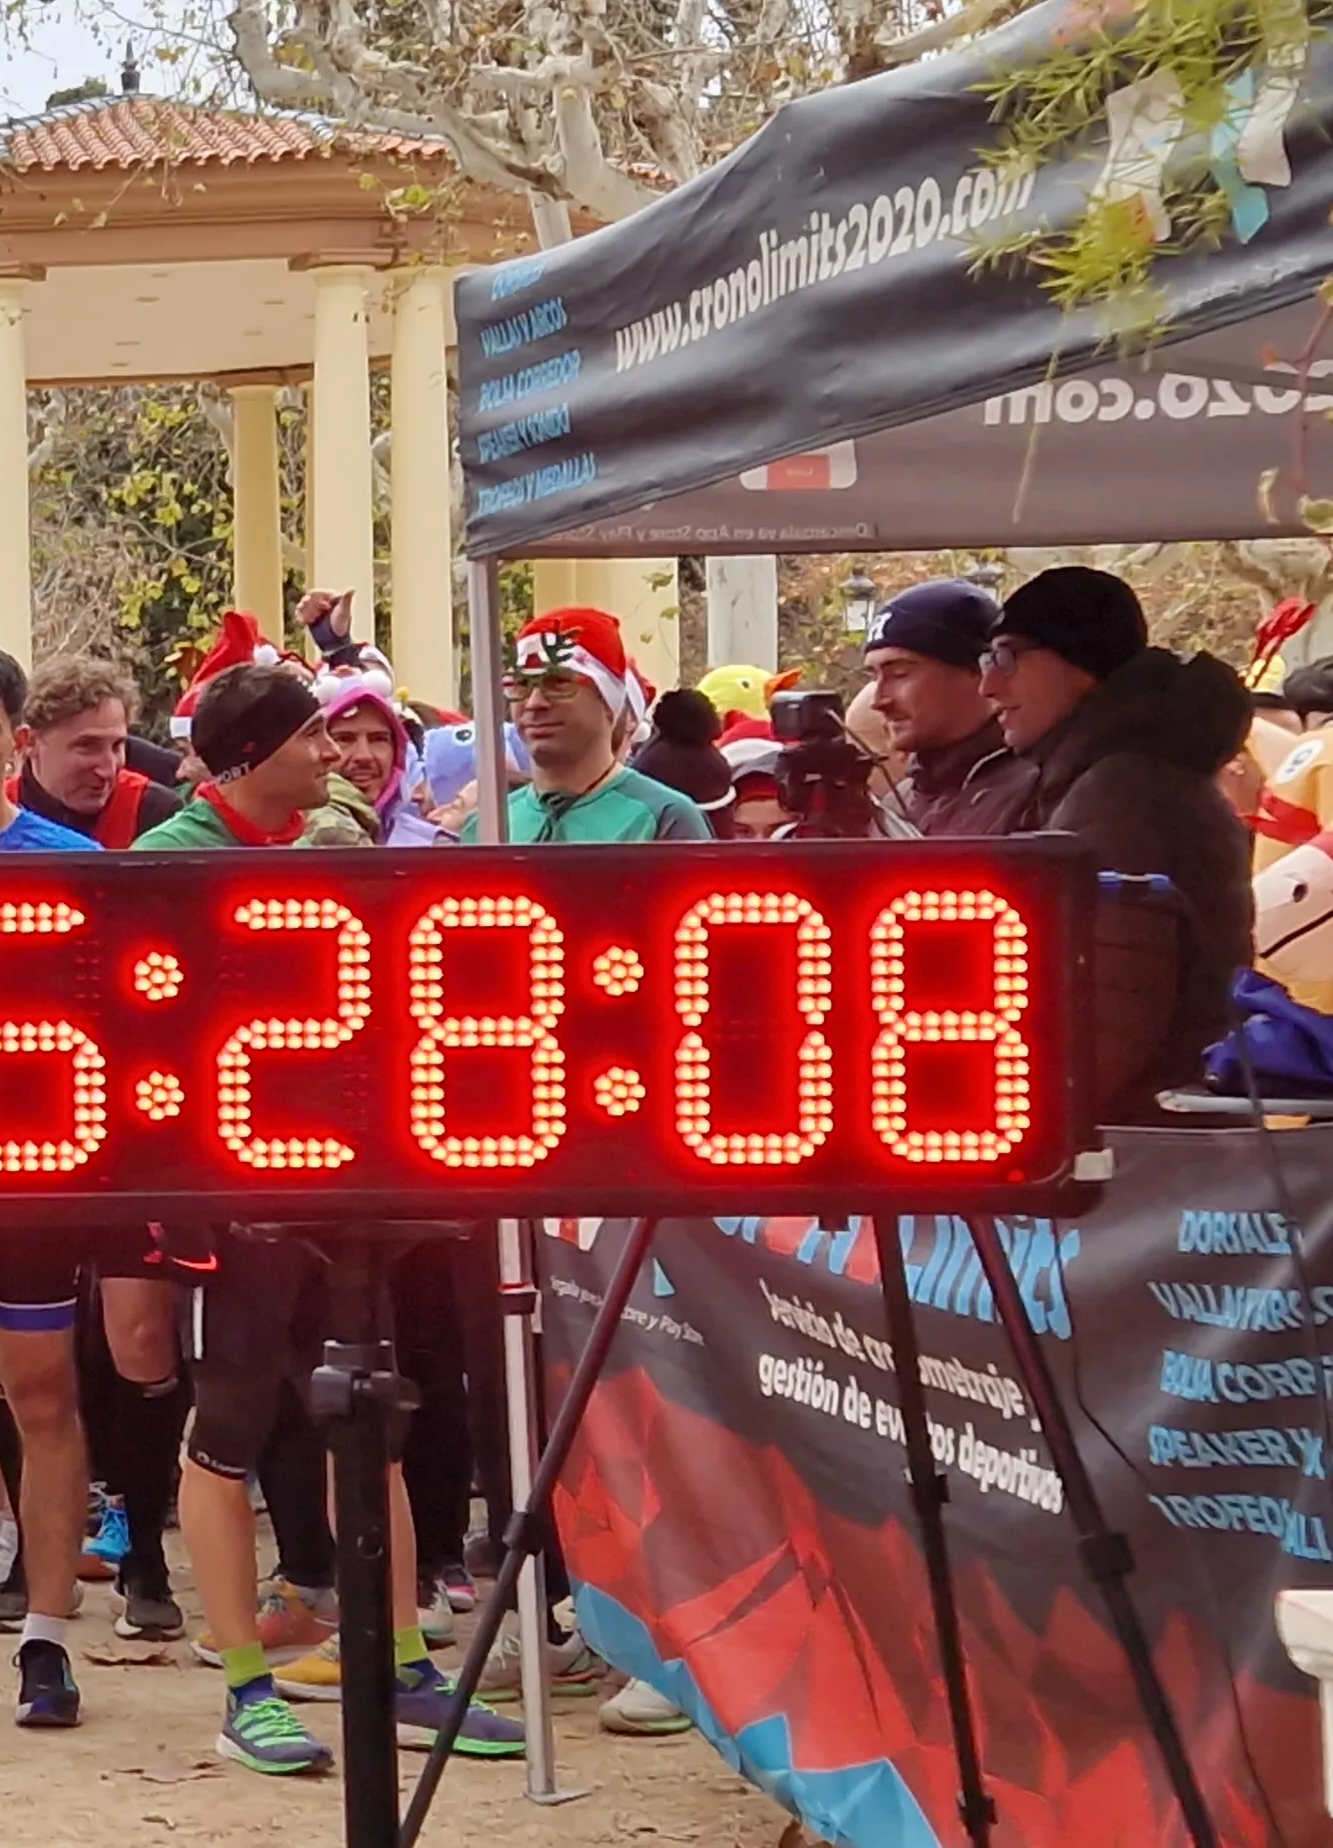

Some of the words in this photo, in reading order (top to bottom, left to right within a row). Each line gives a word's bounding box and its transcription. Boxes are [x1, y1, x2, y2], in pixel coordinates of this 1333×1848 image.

[615, 170, 1034, 373] www.cronolimits2020.com
[759, 1353, 838, 1416] gestión
[843, 1375, 872, 1429] de
[958, 1422, 1063, 1515] deportivos
